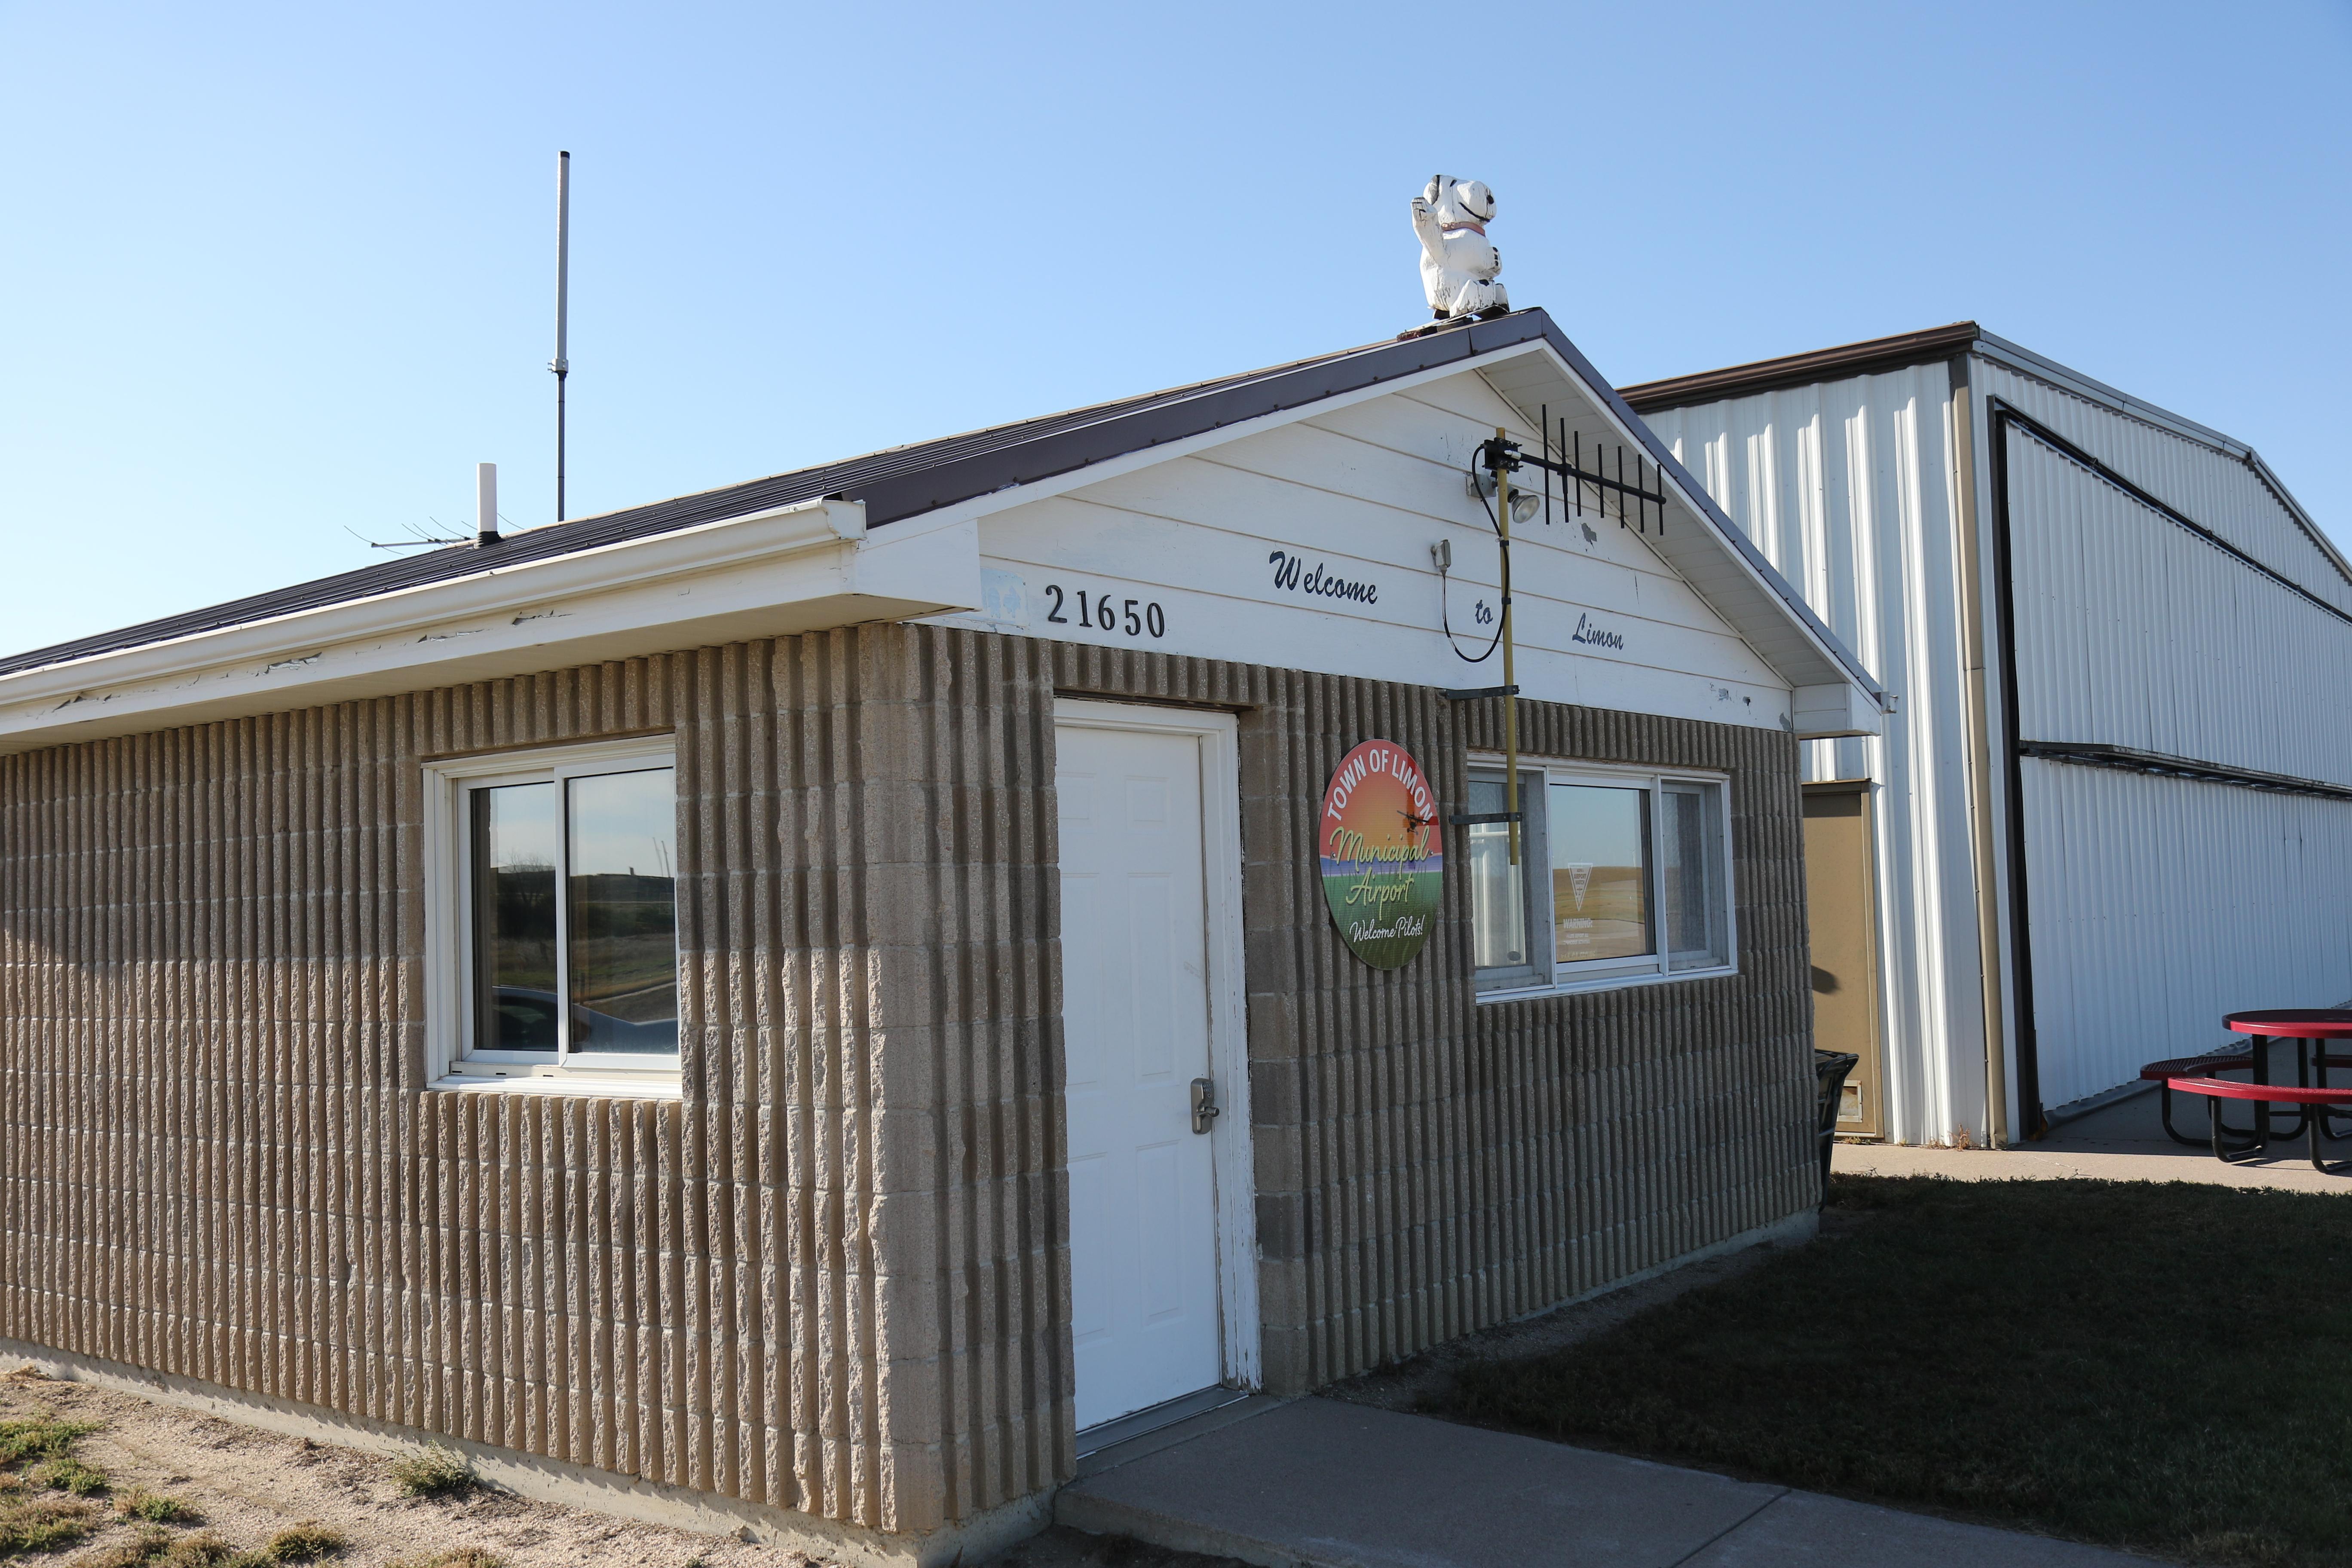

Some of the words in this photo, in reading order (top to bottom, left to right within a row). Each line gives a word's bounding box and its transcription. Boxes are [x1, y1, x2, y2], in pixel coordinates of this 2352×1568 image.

[1045, 585, 1165, 638] 21650
[1269, 551, 1378, 604] Welcome
[1475, 599, 1493, 625] to
[1572, 612, 1623, 650] Limon
[1327, 754, 1367, 821] TOWN
[1369, 749, 1389, 772] OF
[1392, 754, 1433, 825] LIMON
[1330, 825, 1430, 880] Municipal
[1346, 867, 1414, 921] Airport
[1349, 919, 1396, 943] Welcome
[1396, 915, 1425, 938] Pilots!
[1563, 918, 1592, 928] WARNING:
